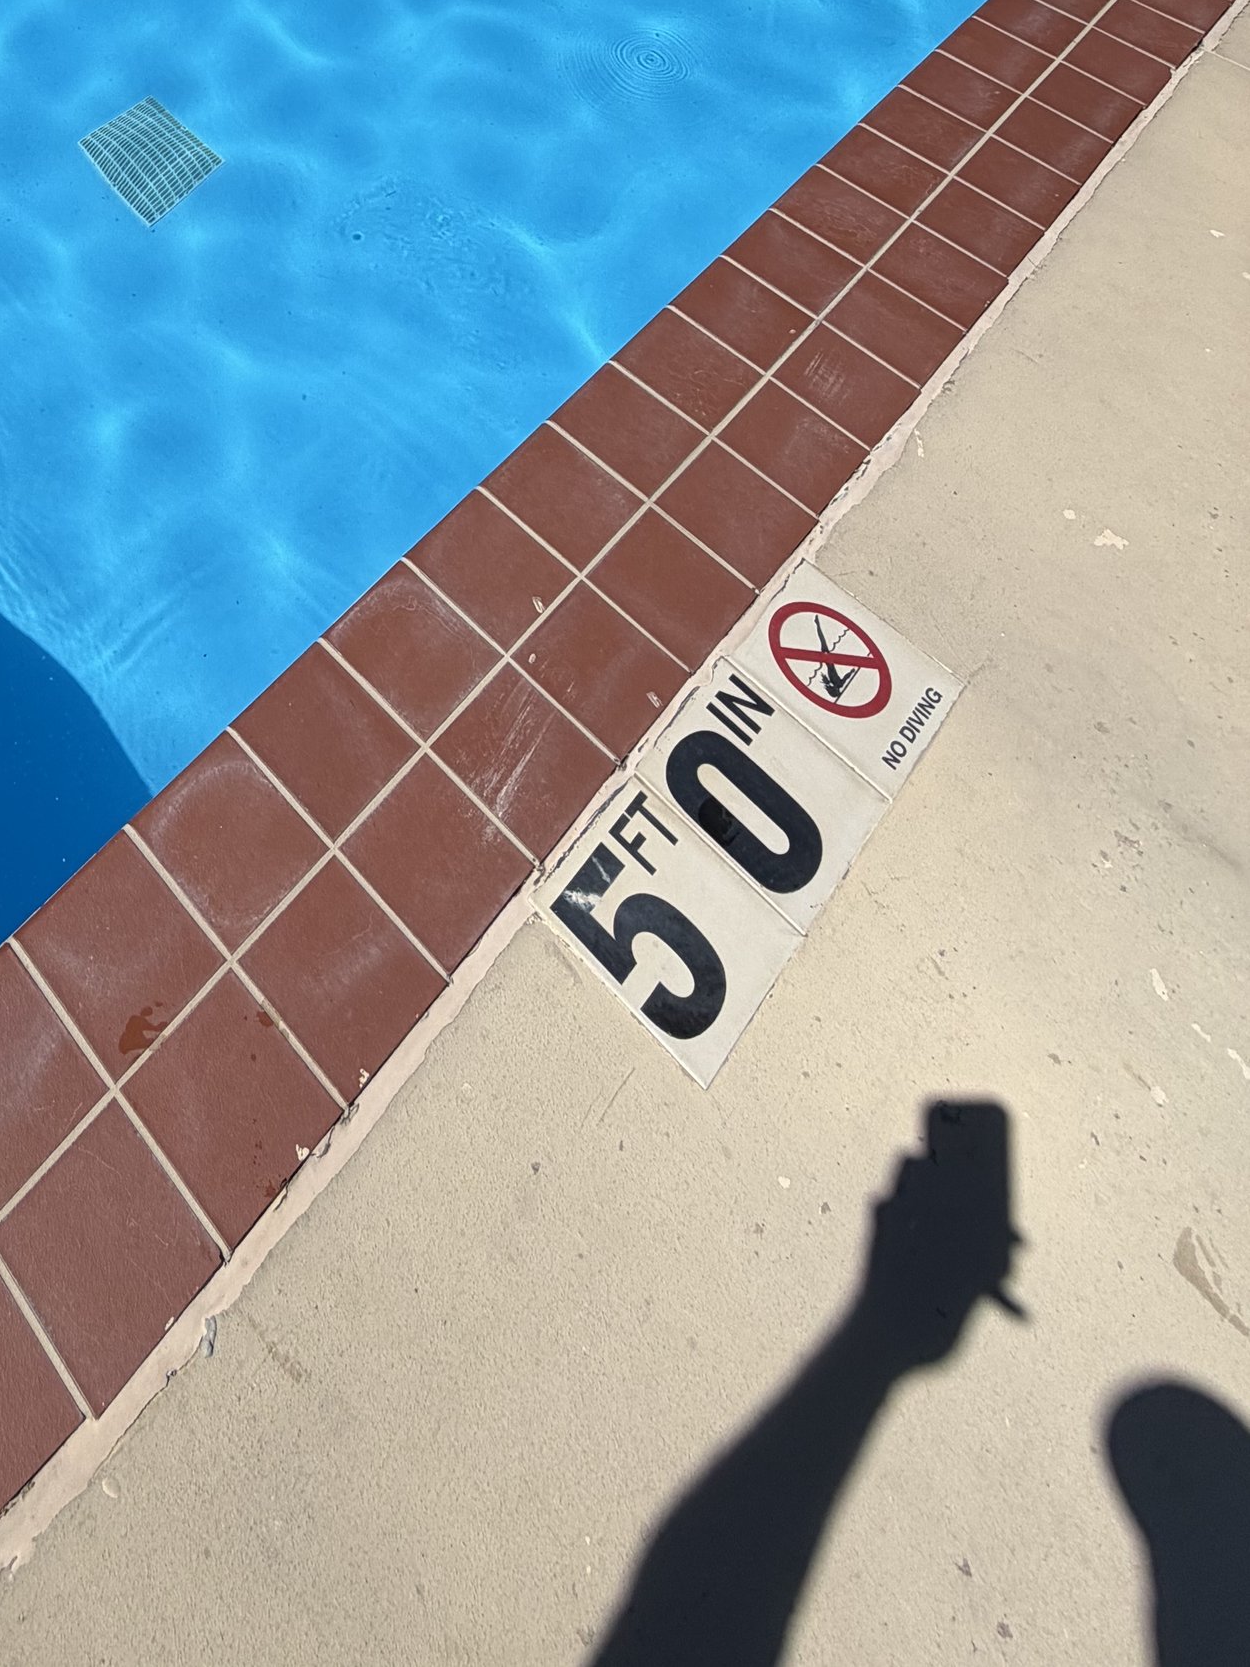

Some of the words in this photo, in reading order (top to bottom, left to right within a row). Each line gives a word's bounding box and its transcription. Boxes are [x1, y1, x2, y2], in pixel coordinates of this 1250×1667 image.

[705, 673, 776, 747] IN
[881, 740, 907, 771] NO
[898, 687, 943, 744] DIVING
[608, 790, 679, 876] FT
[665, 730, 824, 895] 0
[550, 842, 727, 1040] 5
